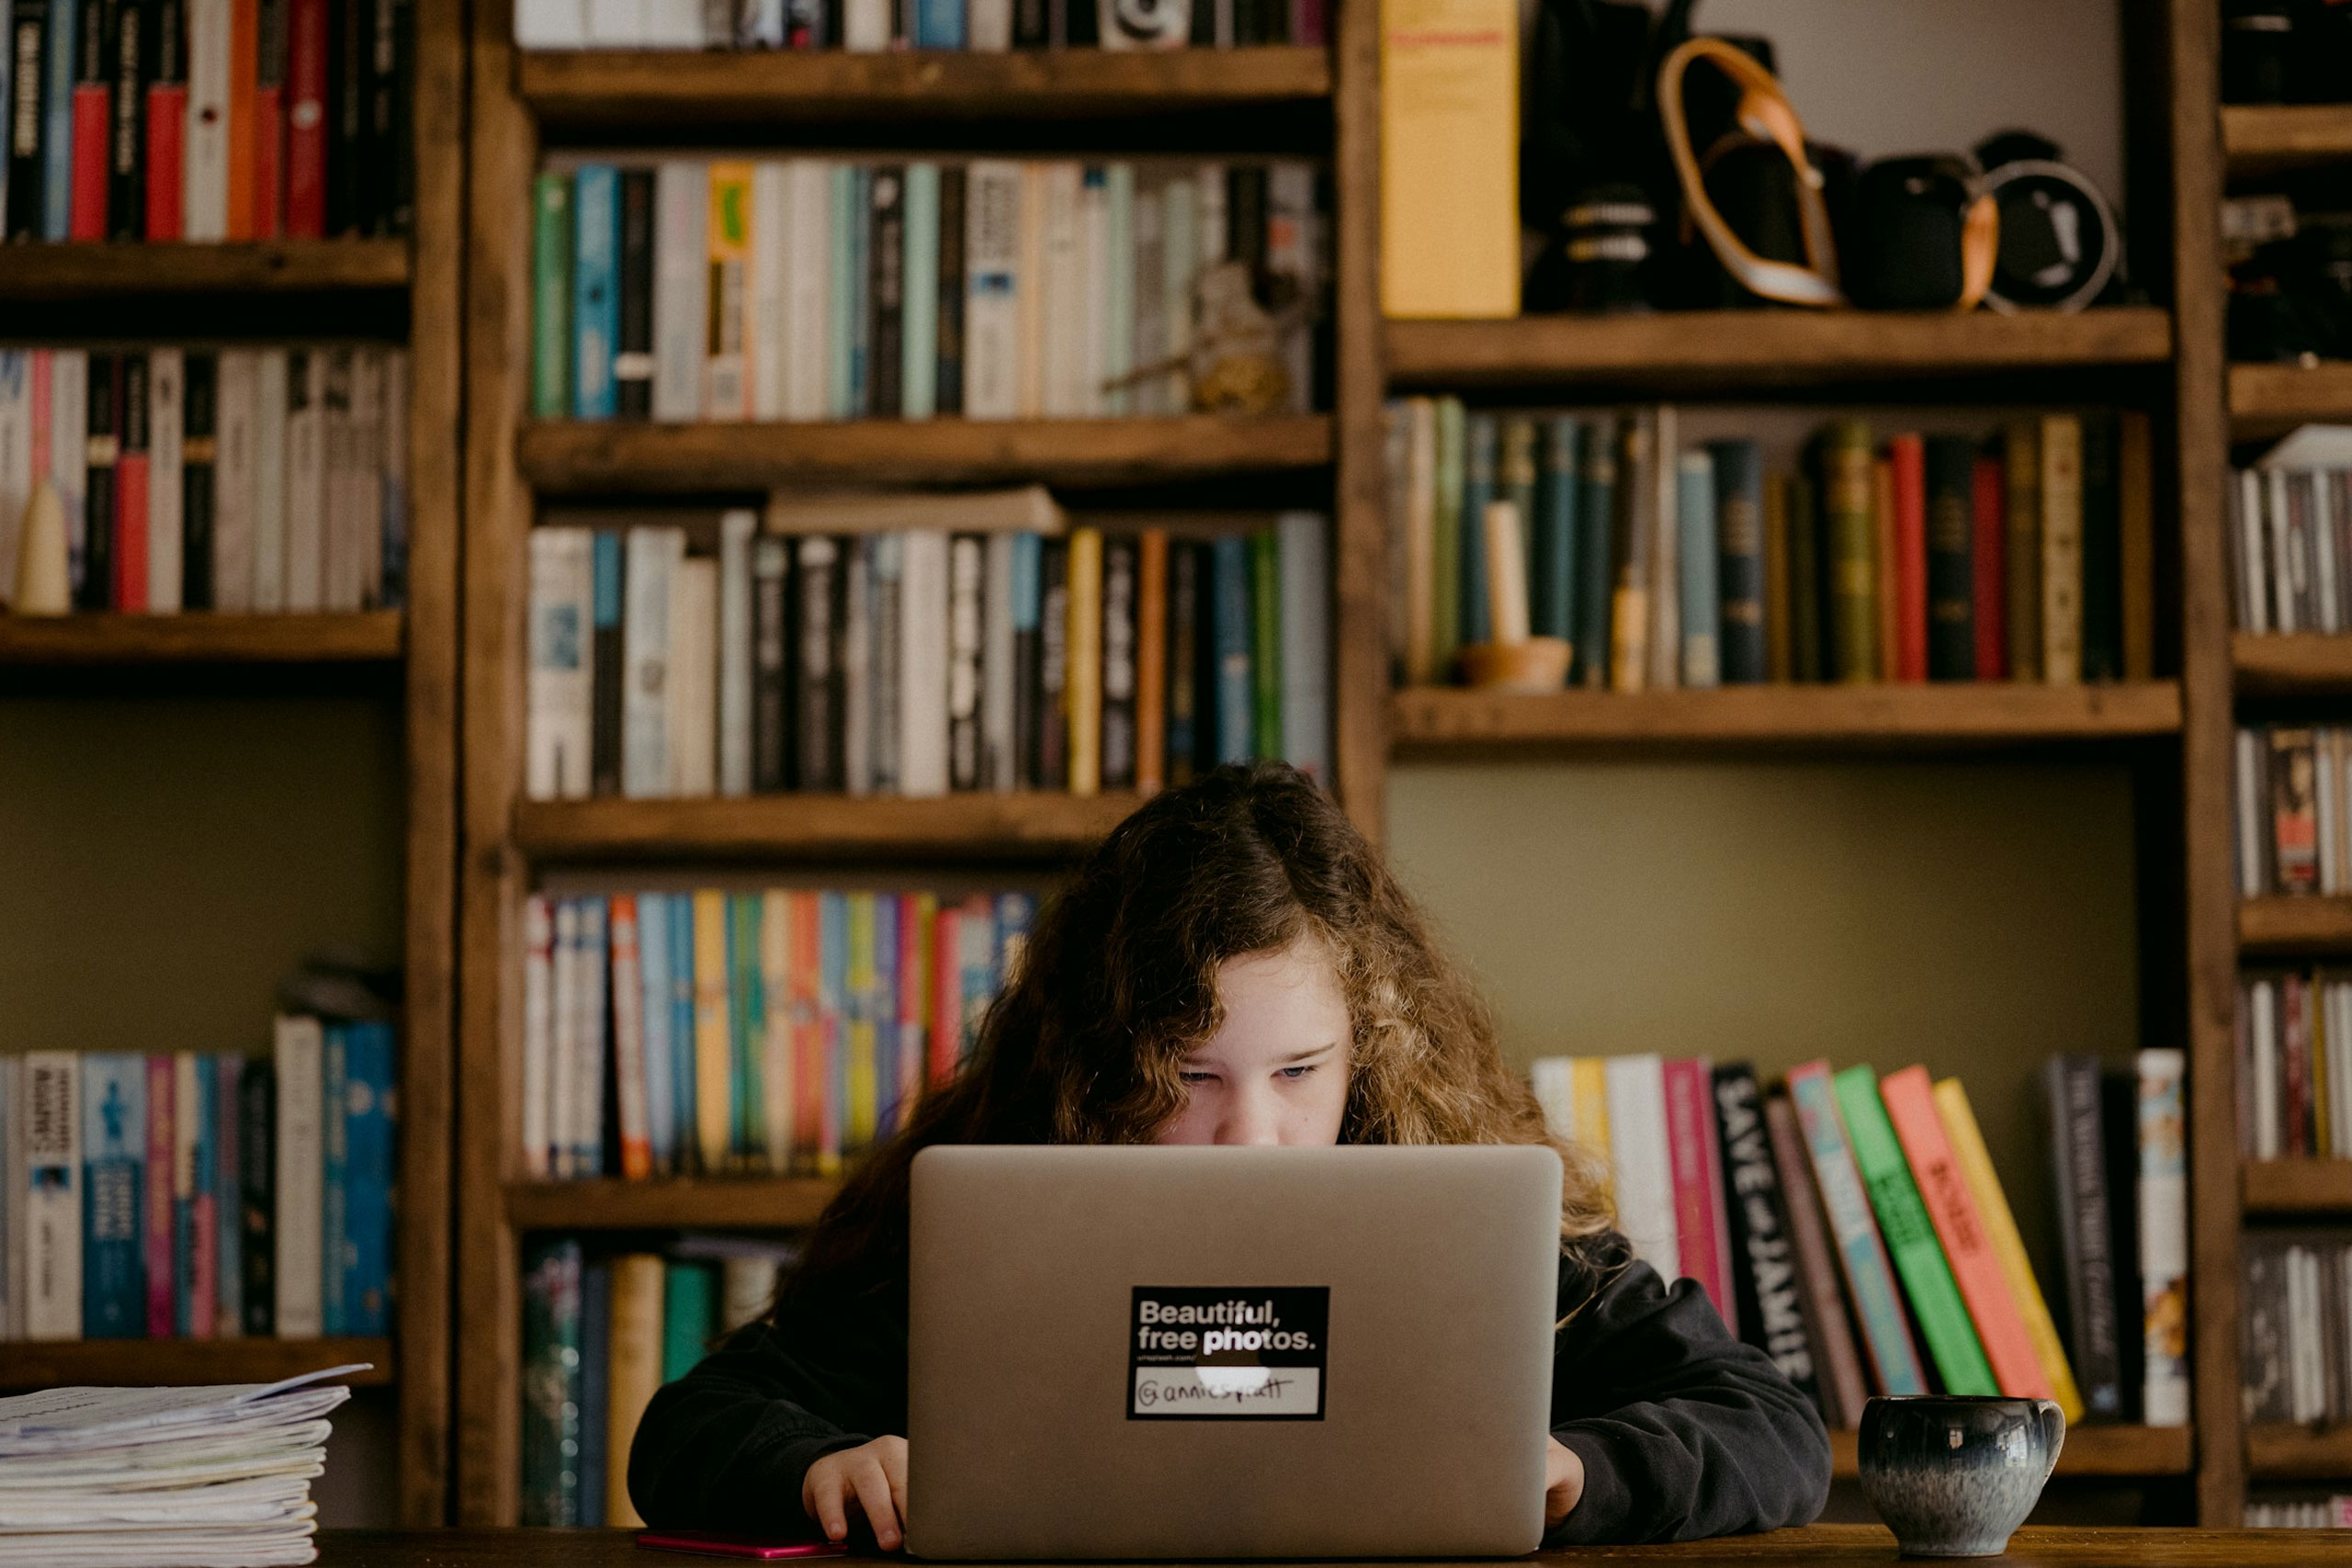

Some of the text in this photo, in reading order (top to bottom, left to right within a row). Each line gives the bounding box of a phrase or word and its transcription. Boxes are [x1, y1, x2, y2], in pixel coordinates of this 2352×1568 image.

[1716, 1076, 1775, 1193] SAVE
[1138, 1300, 1280, 1328] Beautiful,
[1137, 1325, 1317, 1356] free photos.
